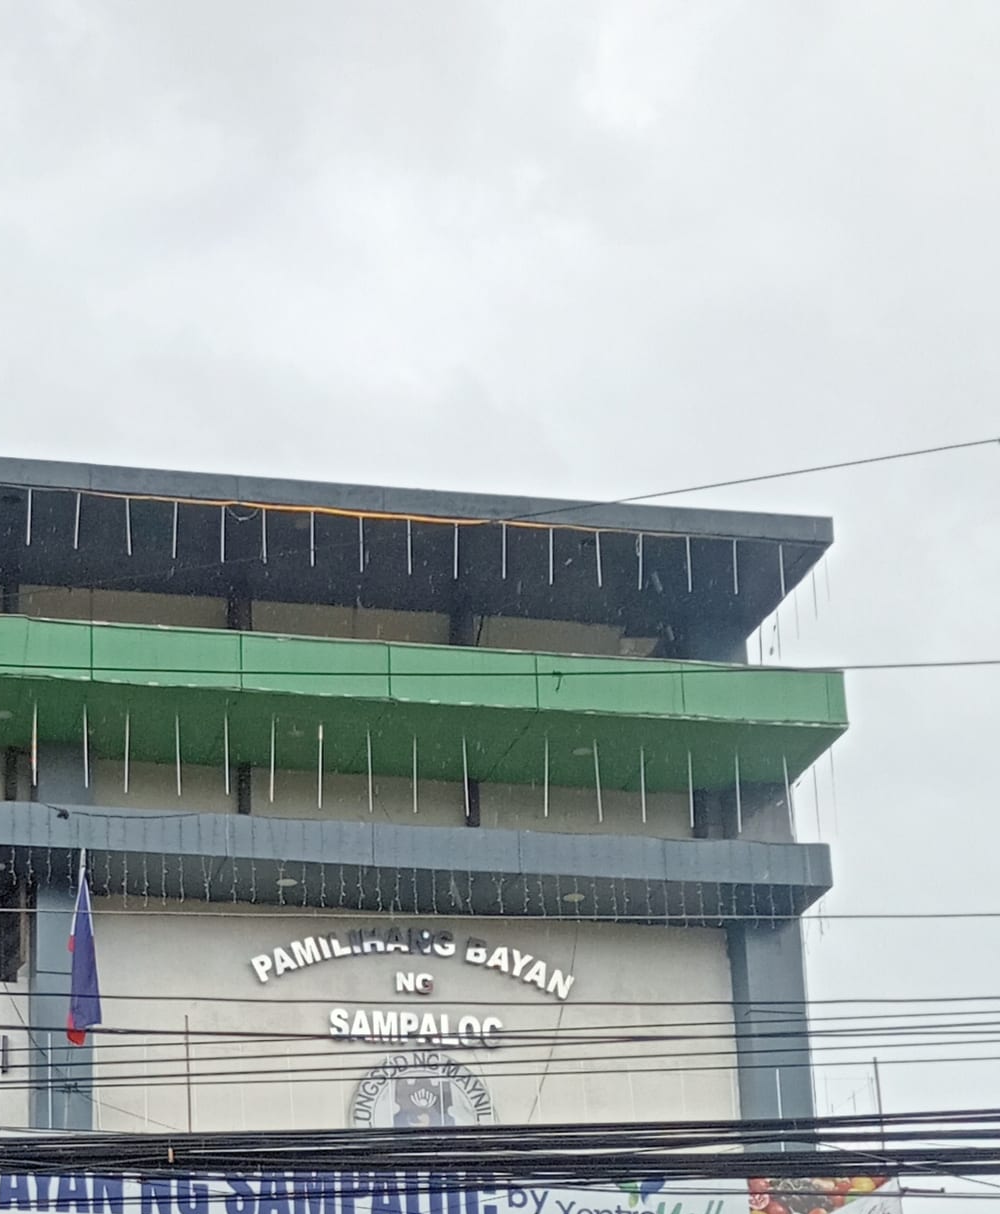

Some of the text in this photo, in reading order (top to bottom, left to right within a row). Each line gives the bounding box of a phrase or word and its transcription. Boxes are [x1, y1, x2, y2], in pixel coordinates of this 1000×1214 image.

[250, 928, 576, 1001] PAMILIHANG BAYAN
[395, 971, 434, 995] NG
[329, 1007, 504, 1050] SAMPALOC
[413, 1051, 441, 1071] NG
